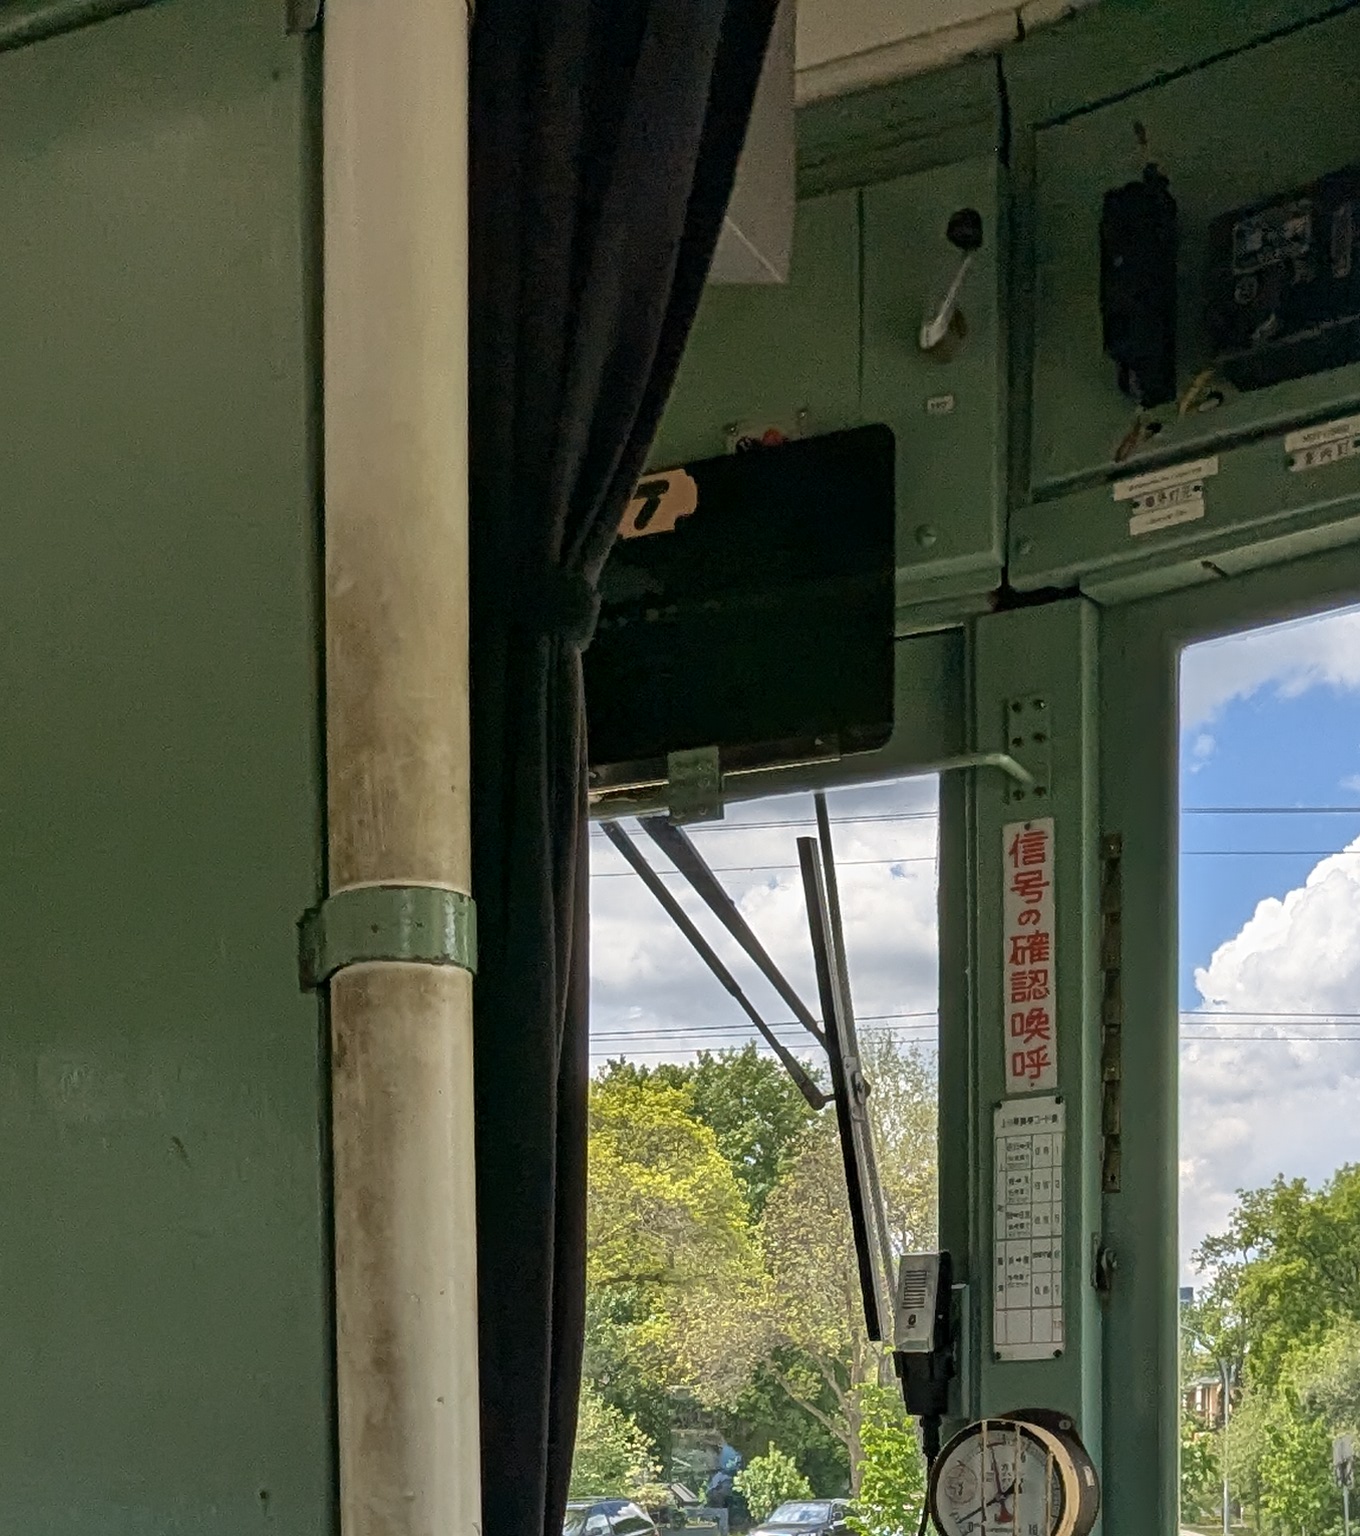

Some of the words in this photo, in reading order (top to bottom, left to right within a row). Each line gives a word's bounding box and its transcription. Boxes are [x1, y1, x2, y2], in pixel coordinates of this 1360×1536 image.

[1008, 830, 1051, 1080] 信号の確認喚呼
